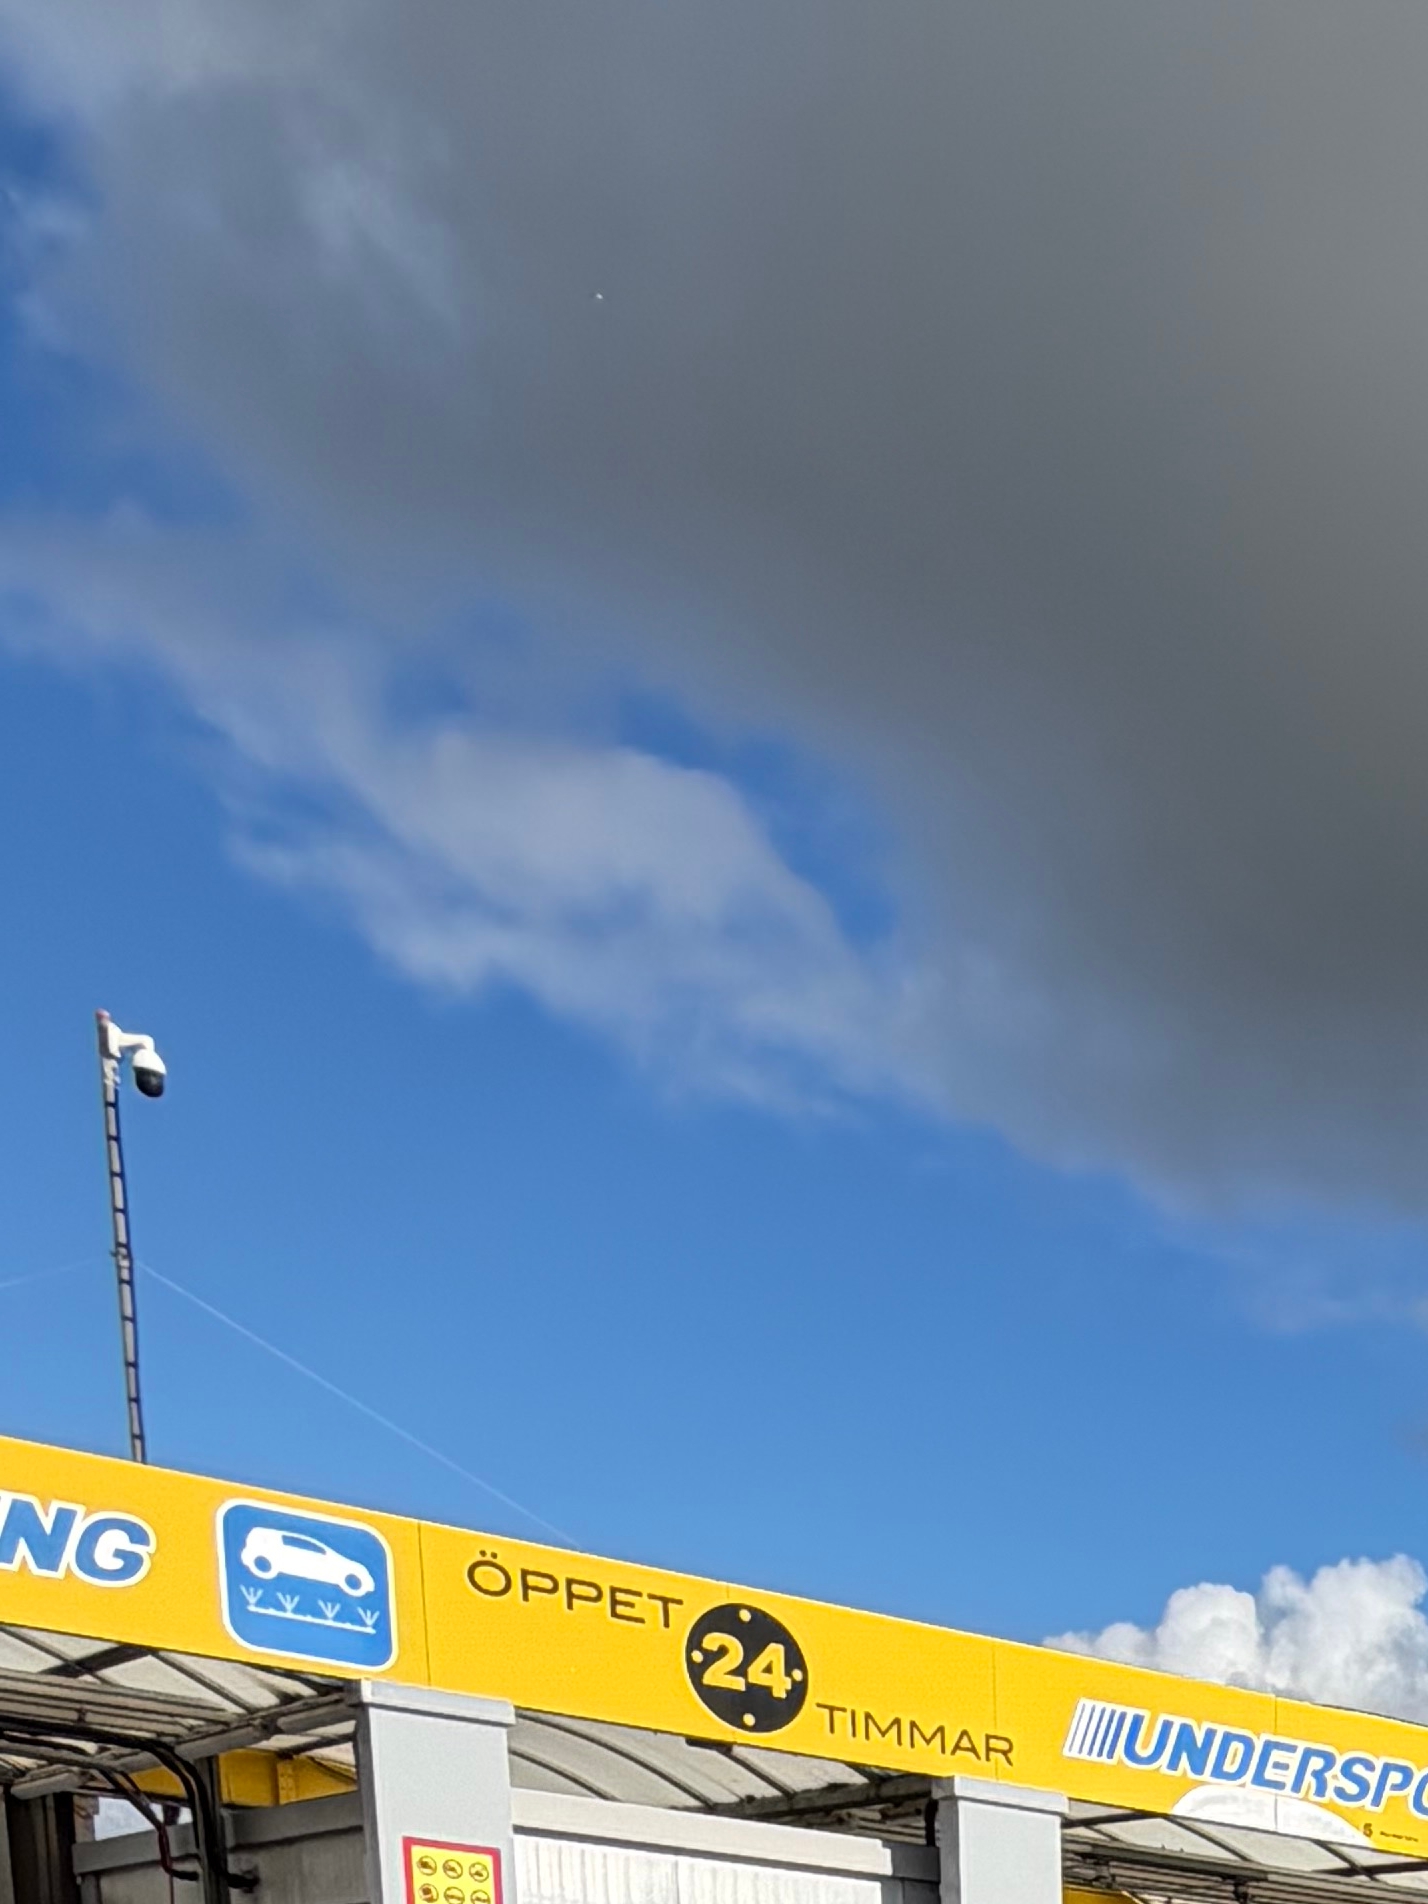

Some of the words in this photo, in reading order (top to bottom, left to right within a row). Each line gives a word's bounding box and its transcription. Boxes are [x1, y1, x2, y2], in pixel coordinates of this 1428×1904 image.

[0, 1495, 152, 1583] NG
[467, 1550, 684, 1629] ÖPPET
[701, 1632, 790, 1699] 24
[815, 1702, 1014, 1767] TIMMAR
